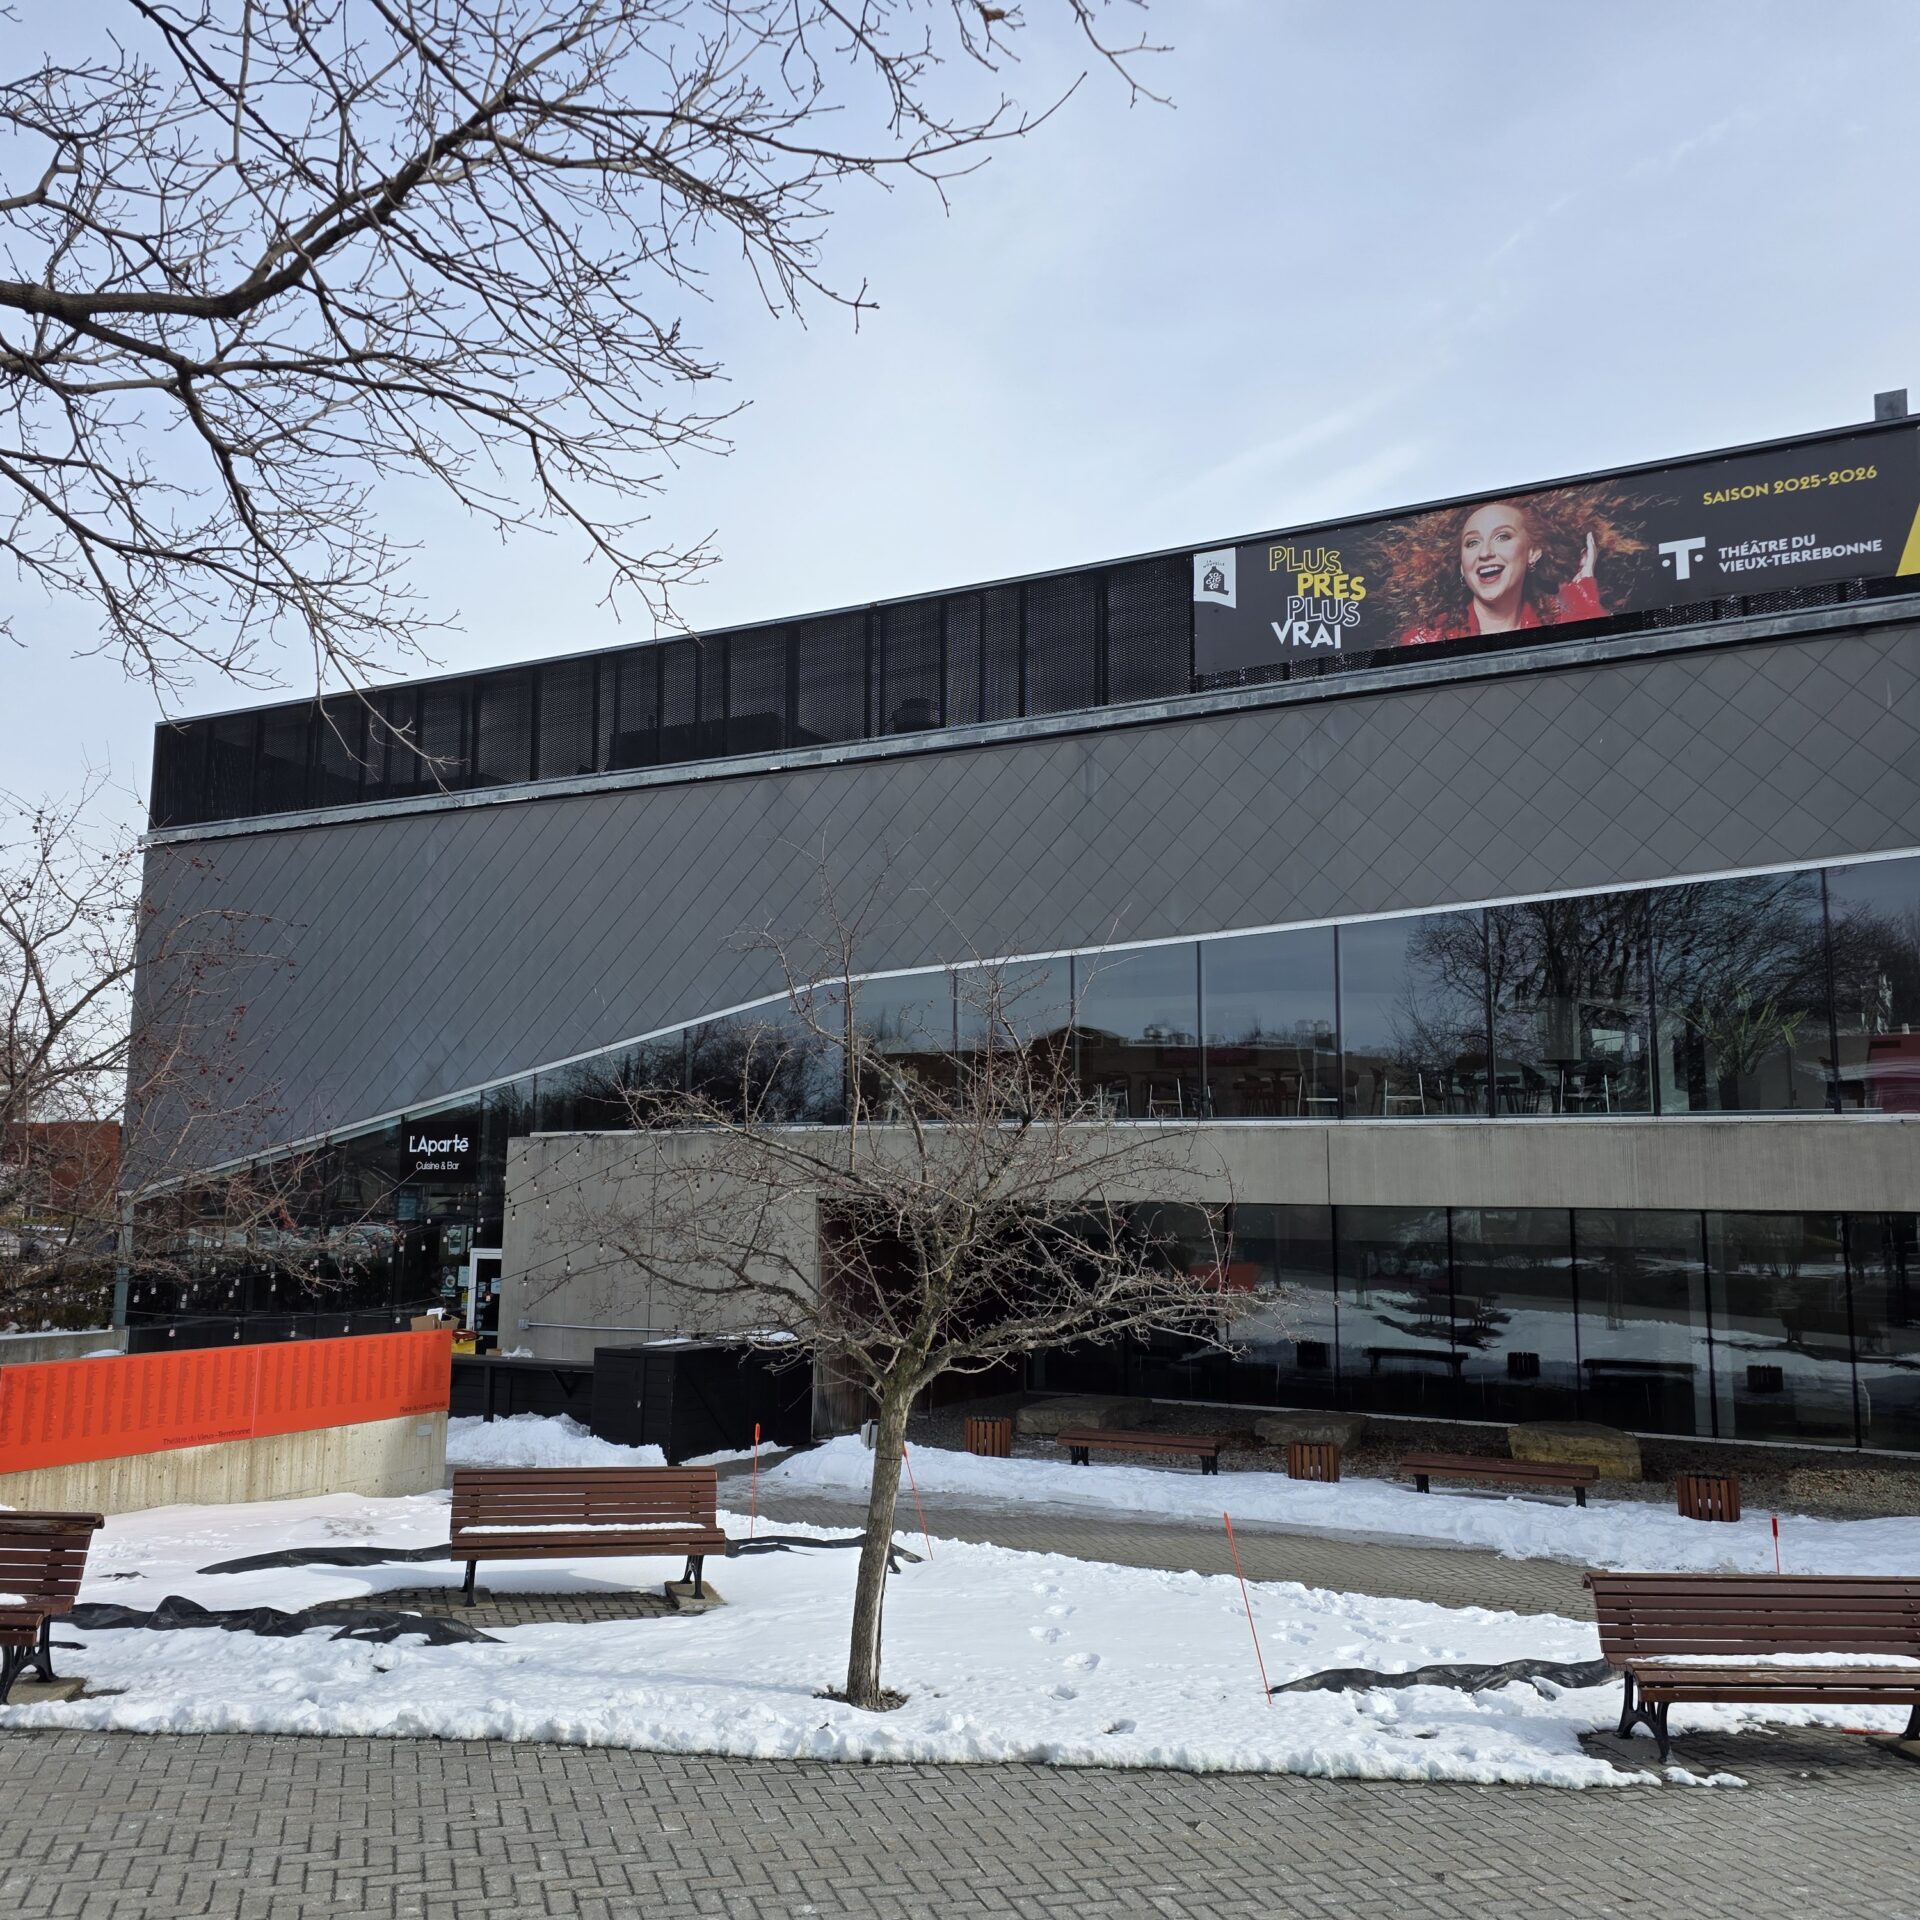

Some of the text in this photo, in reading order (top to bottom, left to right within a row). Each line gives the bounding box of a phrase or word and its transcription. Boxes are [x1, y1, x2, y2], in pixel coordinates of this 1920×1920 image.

[1703, 465, 1878, 505] SAISON 2025-2026
[1269, 546, 1342, 576] PLUS
[1718, 534, 1816, 560] THÉÂTRE DU
[1719, 539, 1883, 573] VIEUX-TERREBONNE
[1287, 595, 1361, 628] PLUS
[1270, 619, 1342, 649] VRAI
[416, 1161, 440, 1170] Cuisine
[447, 1161, 459, 1170] Bar
